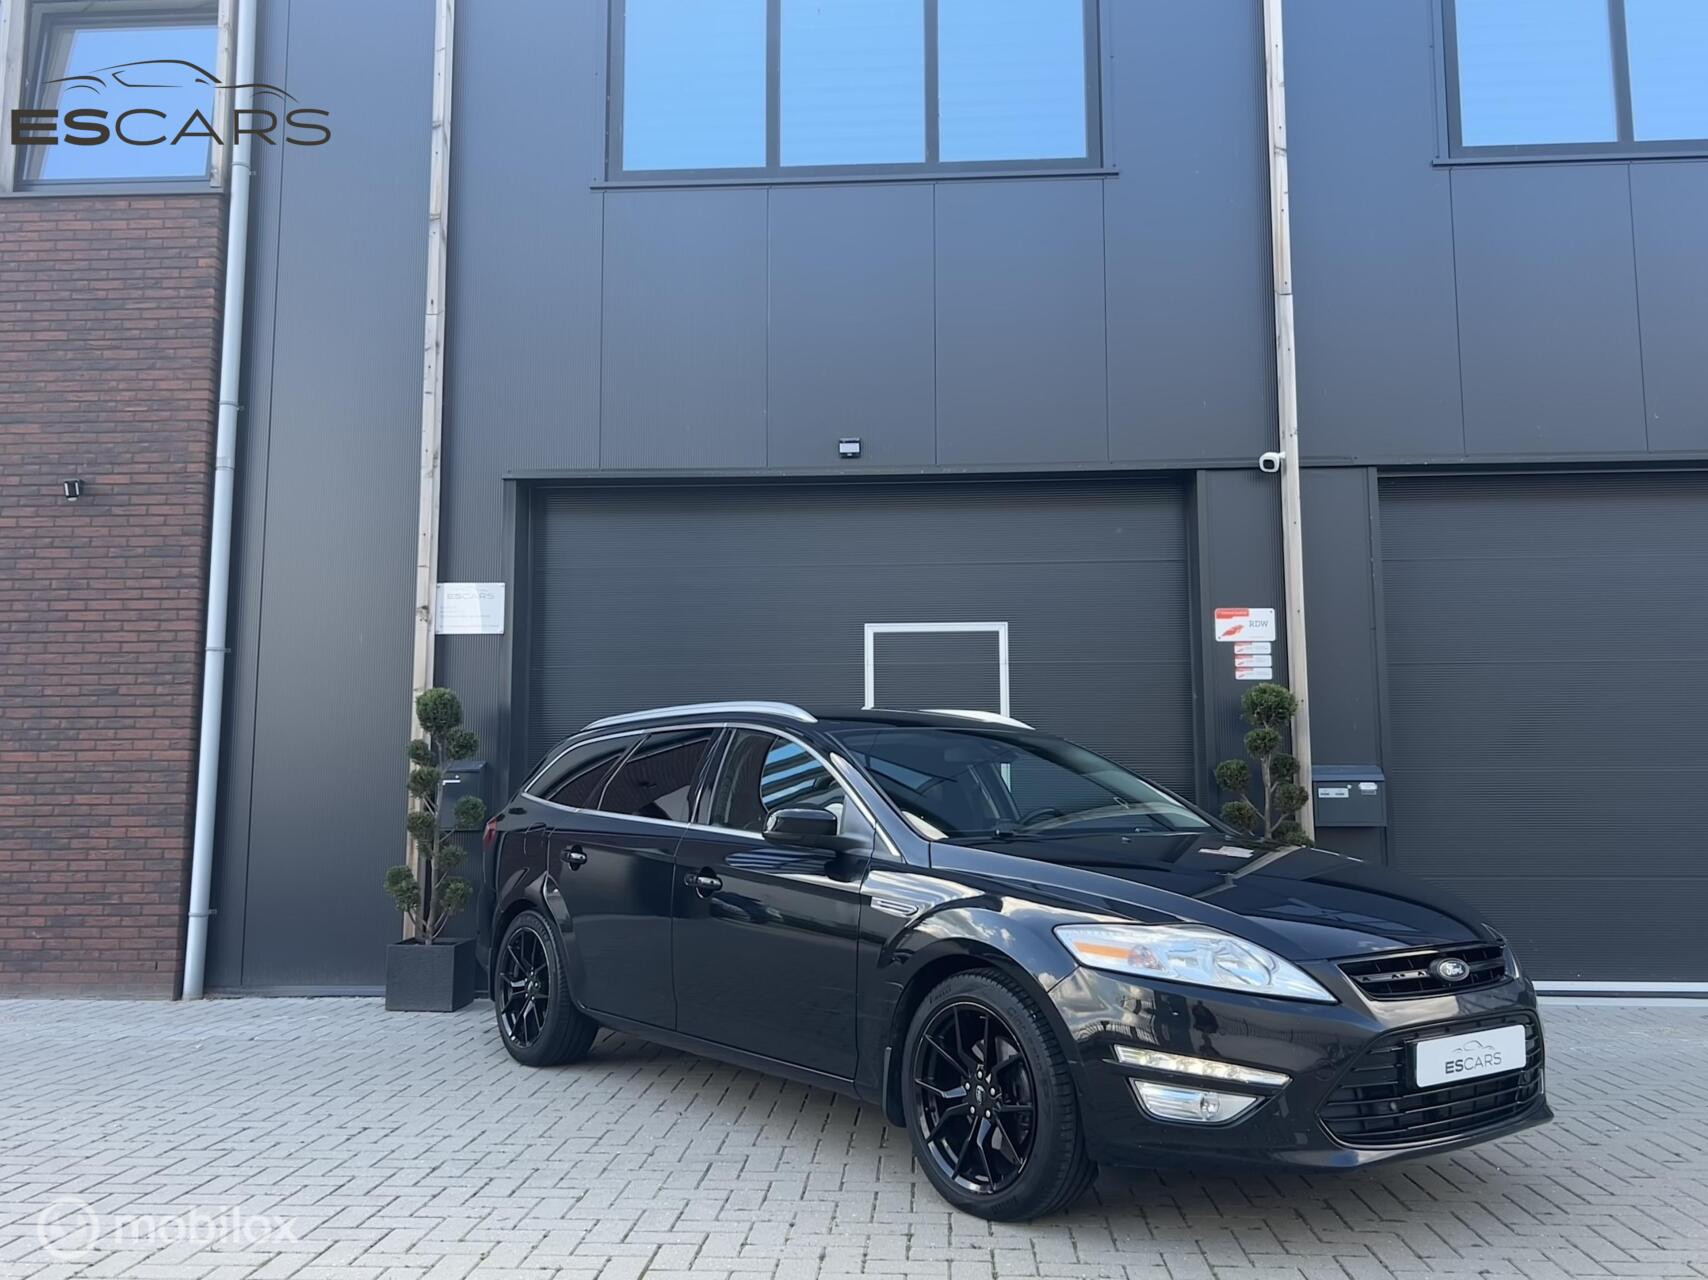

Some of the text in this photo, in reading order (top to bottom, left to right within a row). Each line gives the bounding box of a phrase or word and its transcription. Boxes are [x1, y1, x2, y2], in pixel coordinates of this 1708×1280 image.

[447, 592, 497, 600] ESCARS
[1249, 619, 1269, 628] RDW
[1445, 1052, 1502, 1074] ESCARS
